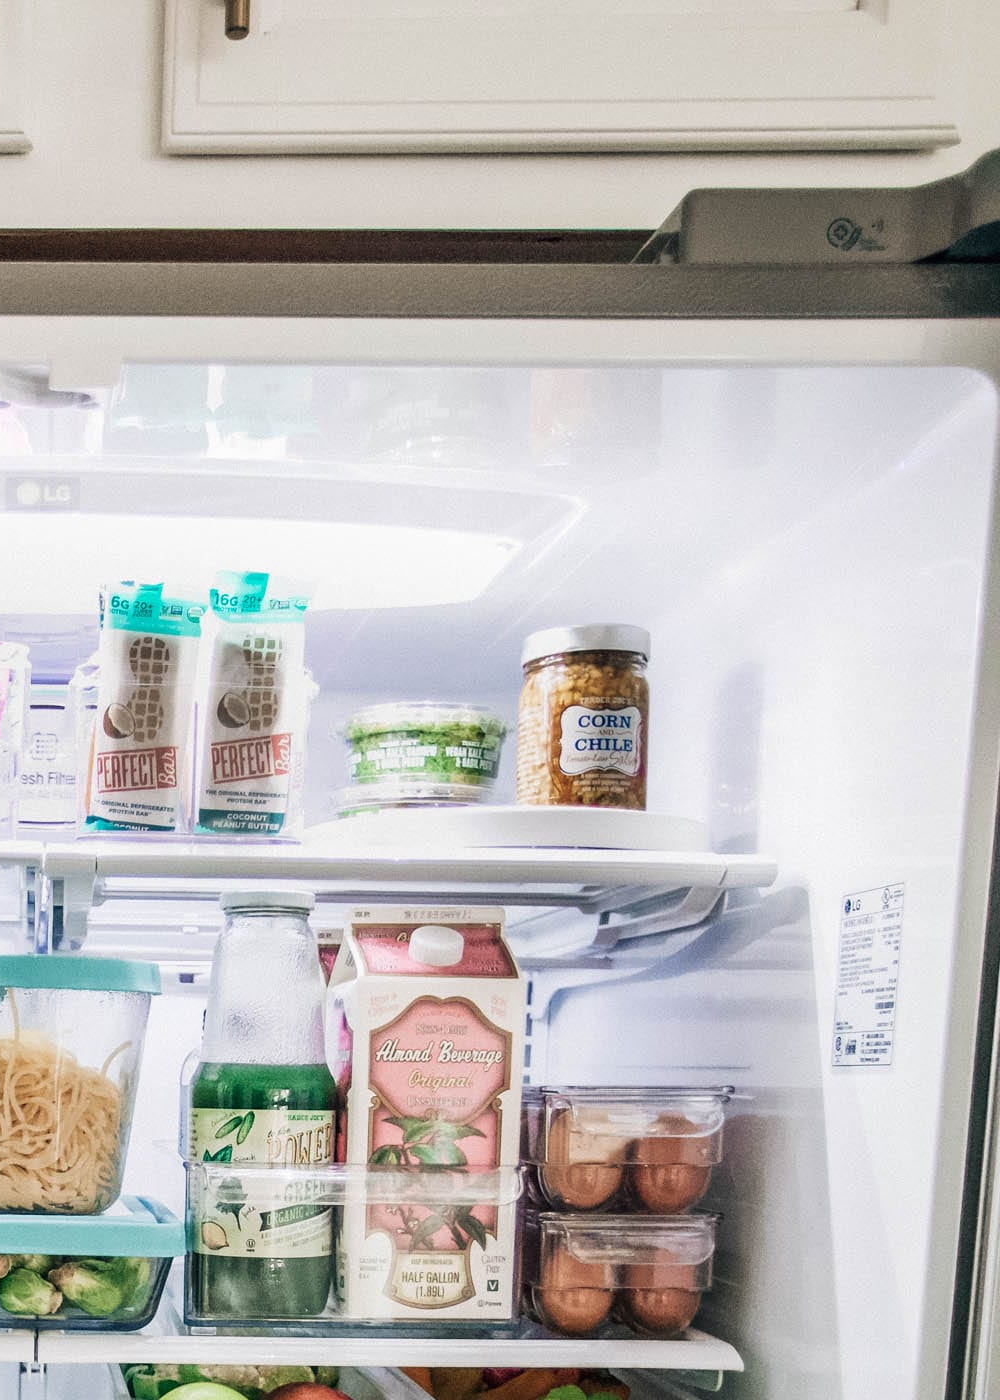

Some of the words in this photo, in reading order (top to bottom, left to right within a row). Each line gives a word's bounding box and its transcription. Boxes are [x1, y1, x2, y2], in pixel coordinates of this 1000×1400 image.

[44, 484, 71, 501] LG
[111, 596, 130, 612] 6G
[215, 592, 238, 606] 16G
[578, 714, 632, 729] CORN
[574, 738, 633, 752] CHILE
[211, 740, 272, 782] PERFECT
[275, 734, 290, 769] Bar
[98, 752, 155, 789] PERFECT
[159, 748, 176, 786] Bar
[212, 820, 246, 828] PEANUT
[226, 813, 268, 821] COCONUT
[375, 1039, 434, 1063] Almond
[438, 1040, 504, 1072] Beverage
[408, 1069, 473, 1093] Original
[266, 1122, 334, 1168] POWER
[401, 1271, 424, 1283] HALF
[426, 1271, 460, 1284] GALLON
[415, 1286, 445, 1299] (1.89L)
